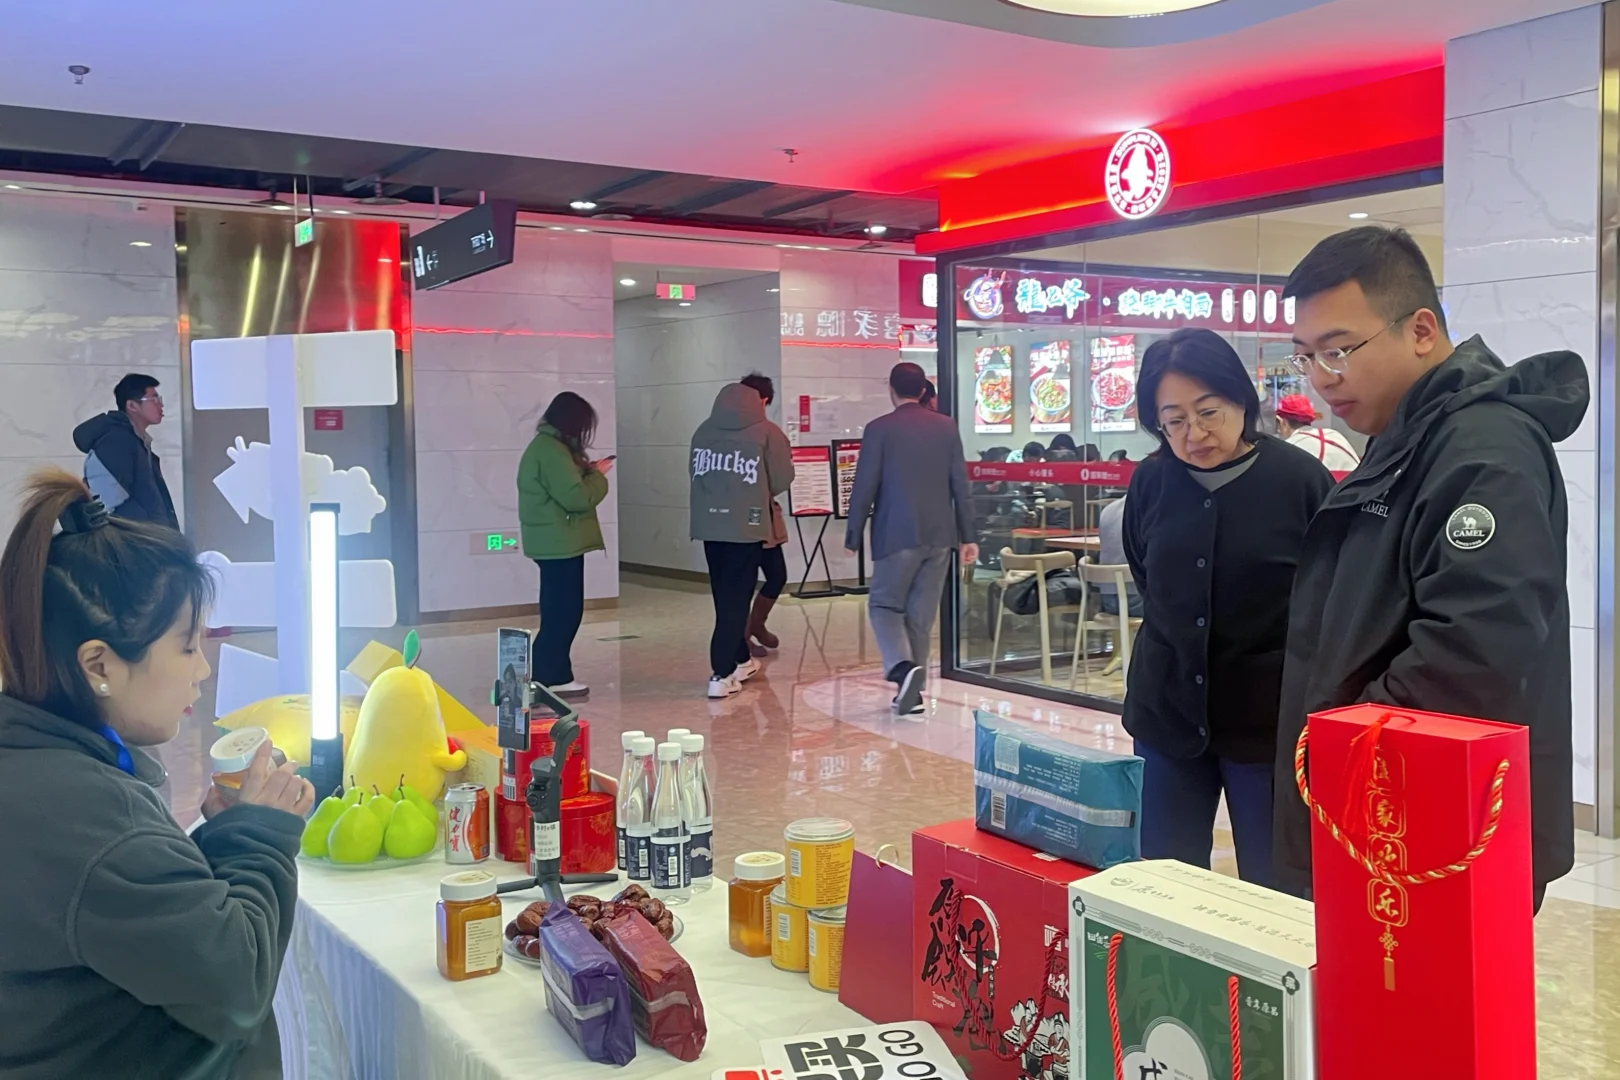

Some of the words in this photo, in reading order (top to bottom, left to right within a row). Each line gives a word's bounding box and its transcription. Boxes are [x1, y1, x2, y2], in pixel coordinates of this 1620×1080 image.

[692, 448, 760, 484] Bucks
[1361, 500, 1389, 518] CAMEL
[931, 990, 956, 1008] Traditional
[932, 999, 944, 1010] Craft
[878, 1029, 924, 1057] GO
